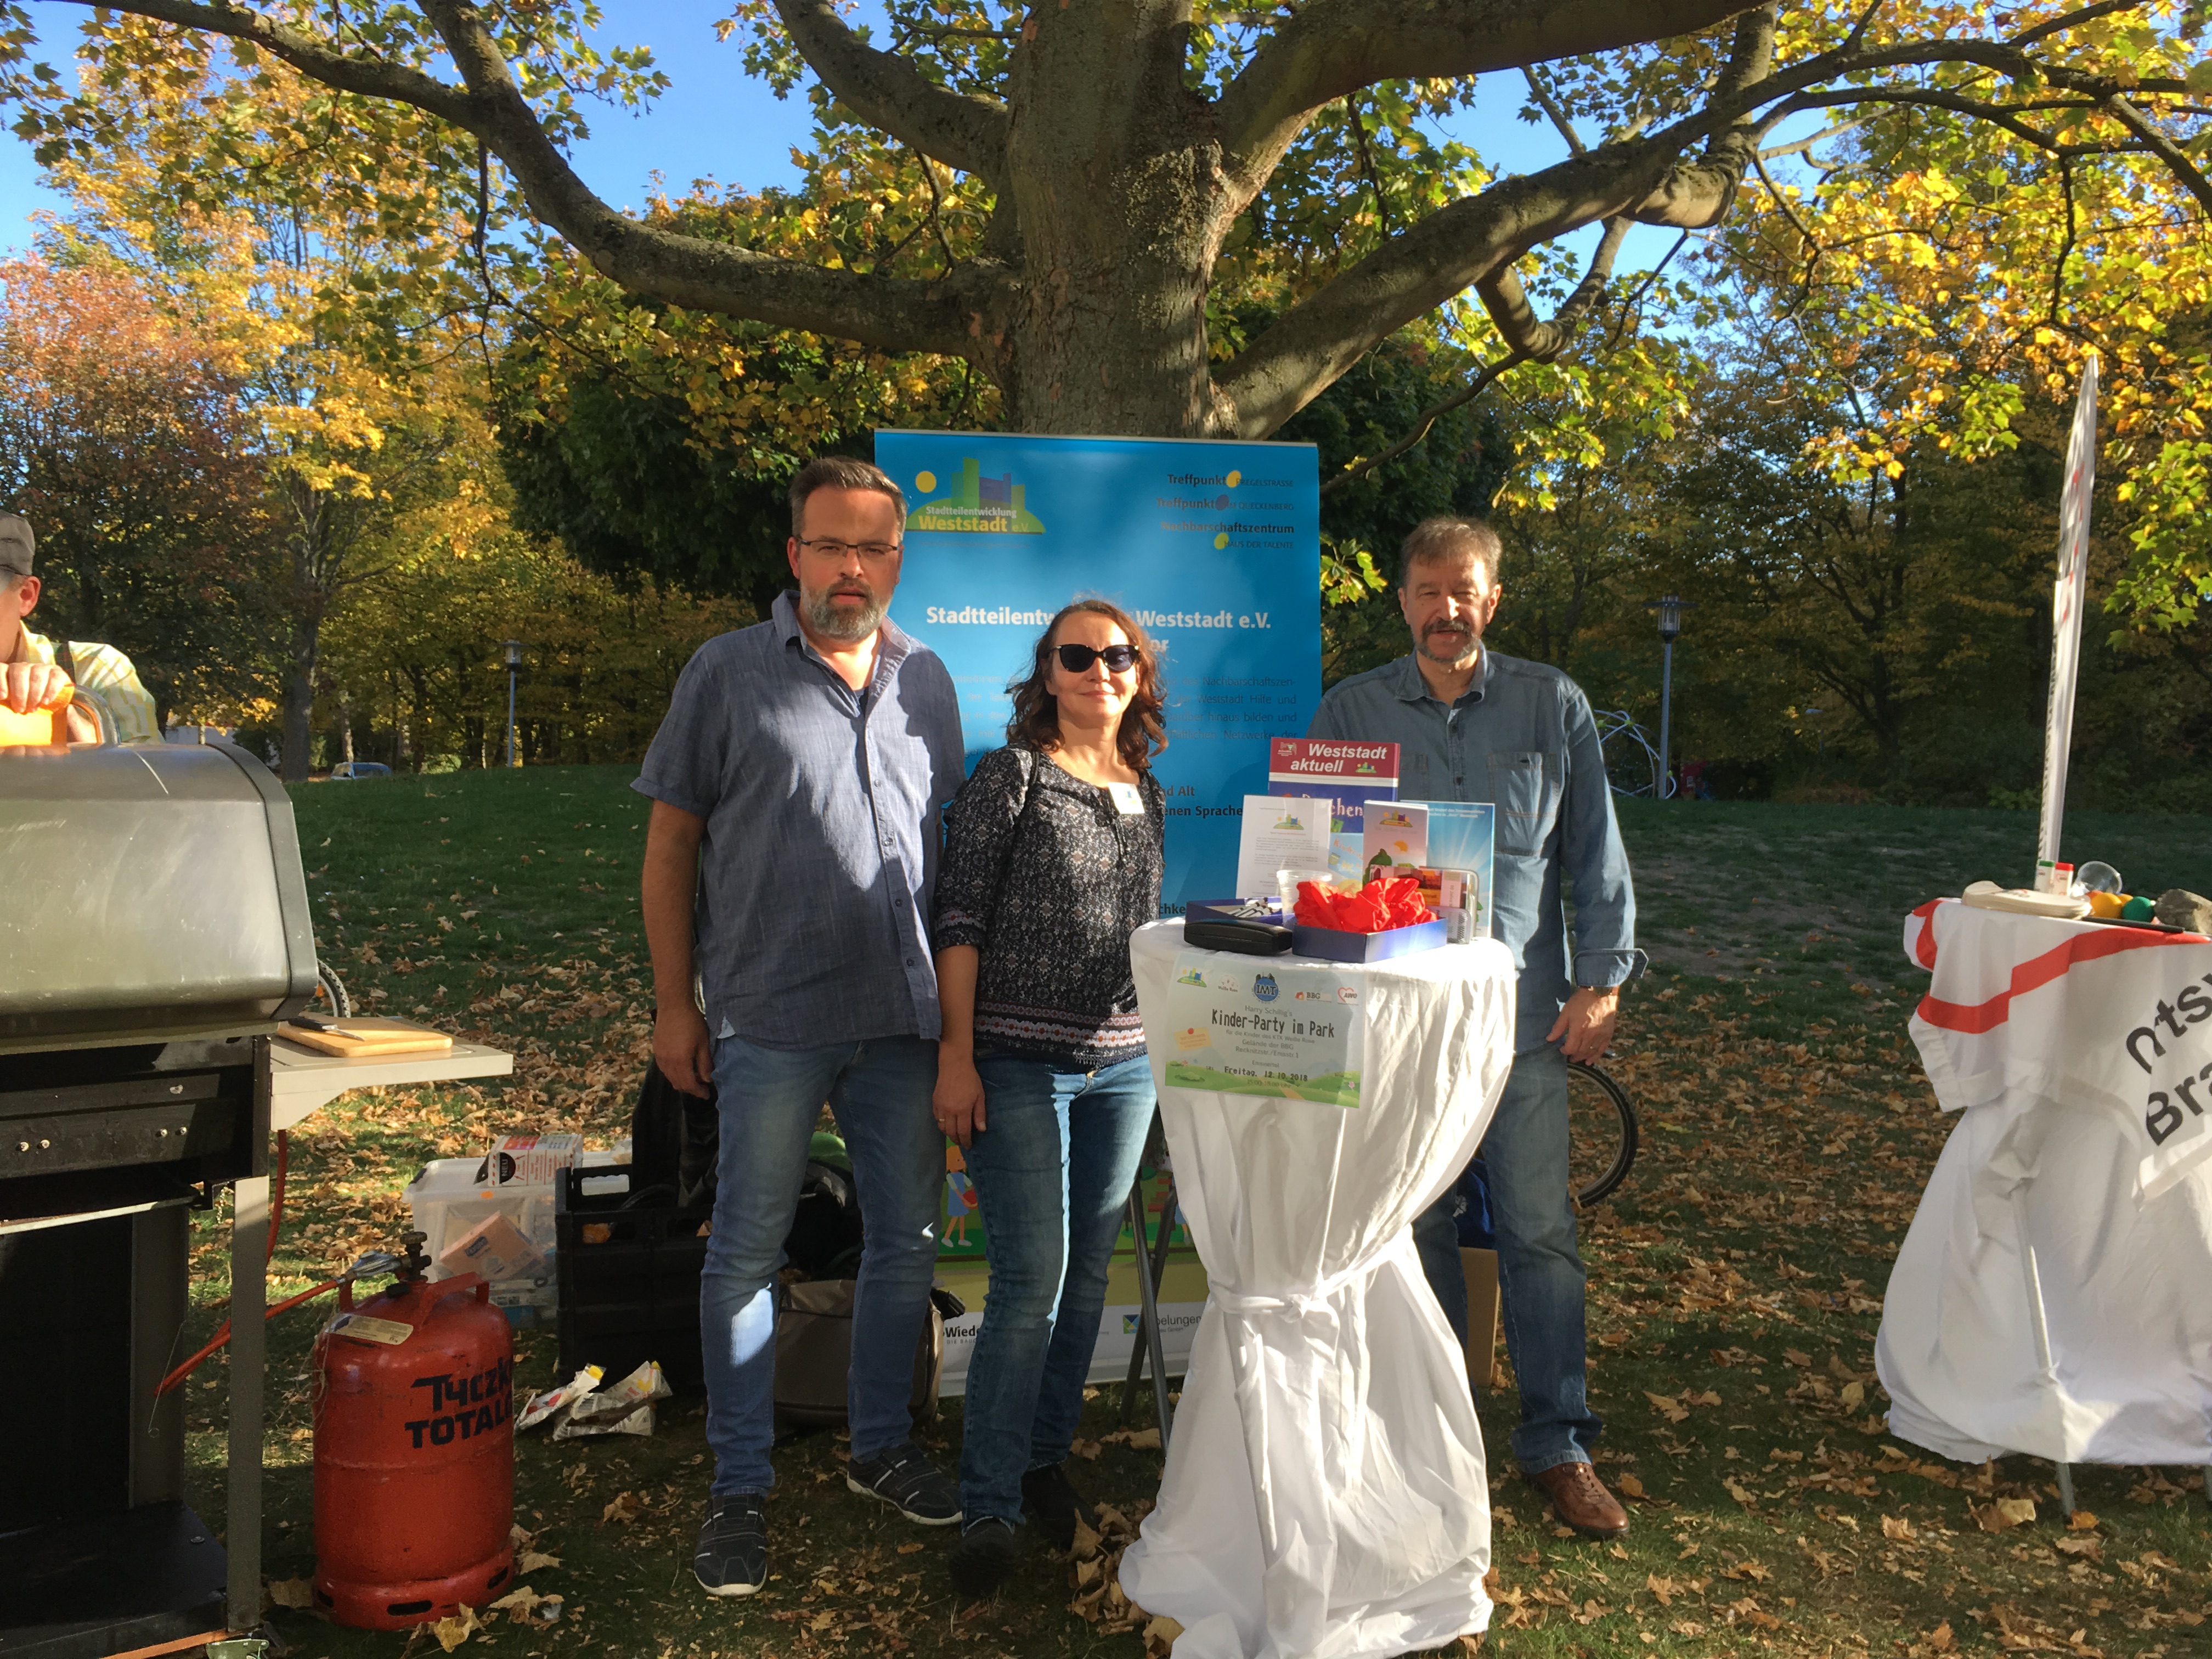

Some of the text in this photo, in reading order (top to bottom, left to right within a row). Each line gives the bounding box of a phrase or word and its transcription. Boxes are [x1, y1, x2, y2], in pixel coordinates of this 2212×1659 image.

[1167, 473, 1227, 487] Treffpunkt
[1156, 497, 1215, 510] Treffpunkt
[926, 506, 1017, 518] Stadtteilentwicklung
[918, 515, 1029, 532] Weststadt e.V.
[1160, 521, 1294, 533] Nachbarschaftszentrum
[927, 606, 1271, 629] Stadtteilentw Weststadt e.V.
[1198, 694, 1244, 704] Weststadt
[1250, 694, 1272, 704] Hilfe
[1278, 695, 1296, 704] und
[1244, 712, 1273, 722] bilden
[1278, 712, 1297, 722] und
[1308, 743, 1387, 760] Weststadt
[1290, 758, 1344, 773] aktuell
[1178, 786, 1195, 796] Alt
[1256, 984, 1276, 996] IMT
[1245, 1005, 1262, 1014] Harry
[1211, 1008, 1335, 1039] Kinder-Party im Park
[945, 1324, 979, 1338] Wied
[404, 1390, 513, 1449] TOTAL
